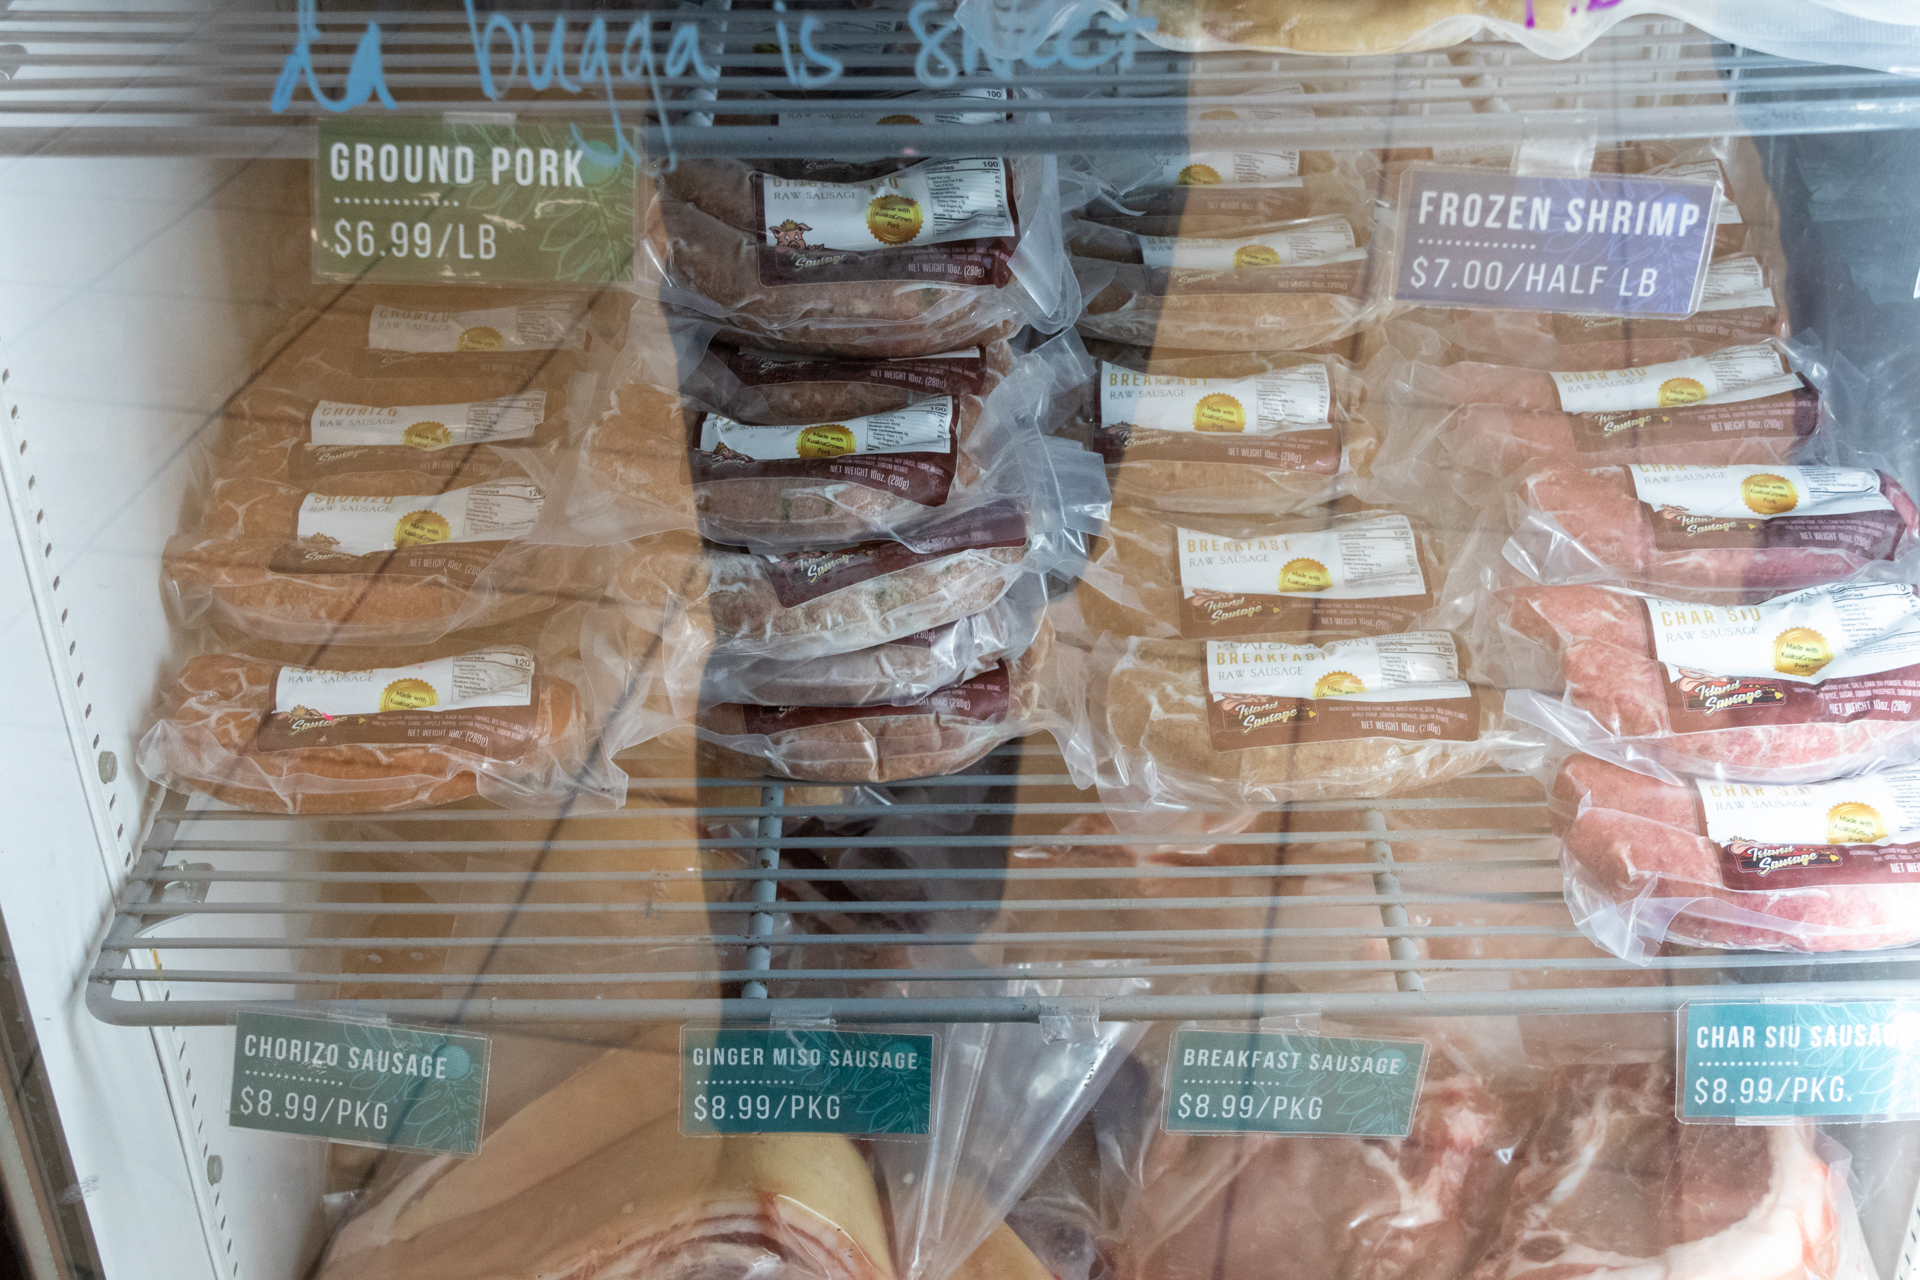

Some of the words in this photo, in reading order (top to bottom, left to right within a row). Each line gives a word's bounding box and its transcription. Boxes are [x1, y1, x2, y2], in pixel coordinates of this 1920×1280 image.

[773, 0, 843, 88] is
[330, 142, 475, 184] GROUND
[491, 146, 584, 187] PORK
[982, 160, 999, 168] 100
[774, 191, 800, 200] RAW
[806, 191, 858, 200] SAUSAGE
[880, 204, 897, 213] Made
[897, 206, 911, 215] with
[1418, 191, 1550, 232] FROZEN
[1565, 199, 1700, 237] SHRIMP
[887, 221, 900, 229] Pork
[334, 218, 498, 260] $6.99/LB
[908, 263, 921, 272] NET
[922, 263, 945, 273] WEIGHT
[947, 264, 962, 275] 10oz.
[1410, 256, 1608, 294] $7.00/HALF
[1618, 267, 1658, 297] LB
[871, 369, 882, 377] NET
[884, 370, 906, 381] WEIGHT
[908, 372, 923, 385] 10oz.
[925, 374, 947, 388] (280g)
[1568, 384, 1593, 393] RAW
[1597, 378, 1647, 389] SAUSAGE
[1109, 390, 1135, 400] RAW
[1138, 389, 1186, 398] SAUSAGE
[1669, 388, 1684, 396] Made
[321, 406, 398, 418] CHORIZO
[1207, 405, 1222, 413] Made
[319, 419, 344, 427] RAW
[348, 418, 397, 426] SAUSAGE
[1603, 415, 1652, 437] Sausage
[1711, 421, 1722, 431] NET
[1723, 420, 1745, 431] WEIGHT
[1747, 420, 1762, 430] 10oz.
[1763, 420, 1783, 431] (280g)
[806, 437, 845, 451] KualoaGrown
[812, 431, 829, 440] Made
[829, 434, 844, 443] with
[1124, 434, 1173, 448] Sausage
[1228, 447, 1240, 456] NET
[1241, 448, 1263, 457] WEIGHT
[1264, 448, 1280, 461] 10oz.
[1280, 450, 1302, 463] (280g)
[830, 464, 842, 474] NET
[844, 465, 868, 478] WEIGHT
[870, 467, 886, 483] 10oz.
[888, 474, 910, 491] (280g)
[1644, 475, 1671, 485] RAW
[1675, 471, 1728, 482] SAUSAGE
[1753, 482, 1770, 490] Made
[1770, 483, 1785, 491] with
[1750, 488, 1788, 500] KualoaGrown
[1763, 496, 1776, 505] Pork
[340, 505, 393, 513] SAUSAGE
[409, 522, 427, 531] Made
[427, 527, 441, 536] with
[1393, 529, 1410, 537] 130
[1686, 520, 1738, 538] Sausage
[1800, 531, 1813, 541] NET
[1815, 532, 1836, 542] WEIGHT
[1187, 539, 1290, 553] BREAKFAST
[423, 558, 446, 568] WEIGHT
[1189, 557, 1215, 567] RAW
[1219, 554, 1269, 564] SAUSAGE
[807, 555, 850, 584] Sausag
[1291, 570, 1308, 579] Made
[1308, 574, 1321, 582] with
[1832, 591, 1864, 600] Calories
[1204, 596, 1246, 612] Island
[1211, 604, 1263, 626] Sausage
[1661, 610, 1715, 627] CHAR
[1728, 607, 1762, 622] SIU
[1321, 617, 1333, 626] NET
[1334, 617, 1358, 626] WEIGHT
[1359, 618, 1375, 628] 10oz.
[1665, 631, 1698, 643] RAW
[1701, 625, 1760, 638] SAUSAGE
[1786, 642, 1804, 652] Made
[1804, 646, 1819, 654] with
[514, 657, 531, 668] 120
[1216, 652, 1327, 666] BREAKFAST
[1780, 651, 1823, 663] KualoaGrown
[1794, 662, 1810, 670] Pork
[320, 675, 374, 683] SAUSAGE
[1218, 669, 1245, 681] RAW
[1250, 666, 1304, 677] SAUSAGE
[1327, 685, 1344, 694] Made
[1694, 680, 1742, 700] Island
[395, 690, 412, 699] Made
[413, 694, 428, 704] with
[1703, 689, 1763, 716] Sausage
[1235, 700, 1280, 720] Island
[1829, 702, 1844, 714] NET
[1844, 700, 1871, 714] WEIGHT
[1872, 699, 1890, 711] 10oz.
[1891, 700, 1912, 714] (280g)
[1242, 708, 1298, 734] Sausage
[1361, 720, 1374, 730] NET
[1375, 721, 1399, 731] WEIGHT
[1401, 722, 1417, 733] 10oz.
[1419, 723, 1441, 735] (280g)
[407, 729, 420, 737] NET
[422, 729, 447, 738] WEIGHT
[465, 731, 489, 747] (280g)
[1709, 785, 1765, 798] CHAR
[1716, 801, 1745, 811] RAW
[1752, 800, 1813, 810] SAUSAGE
[1839, 815, 1857, 825] Made
[1859, 819, 1874, 828] with
[1747, 844, 1796, 862] Island
[1758, 852, 1818, 877] Sausage
[1889, 862, 1905, 874] NET
[1696, 1026, 1755, 1048] CHAR
[1764, 1026, 1801, 1048] SIU
[244, 1034, 339, 1067] CHORIZO
[347, 1047, 448, 1079] SAUSAGE
[692, 1047, 765, 1066] GINGER
[773, 1048, 822, 1066] MISO
[829, 1050, 918, 1070] SAUSAGE
[1183, 1048, 1301, 1070] BREAKFAST
[1309, 1054, 1401, 1075] SAUSAGE
[1694, 1077, 1852, 1104] $8.99/PKG.
[240, 1086, 388, 1130] $8.99/PKG
[694, 1094, 841, 1121] $8.99/PKG
[1178, 1092, 1323, 1120] $8.99/PKG
